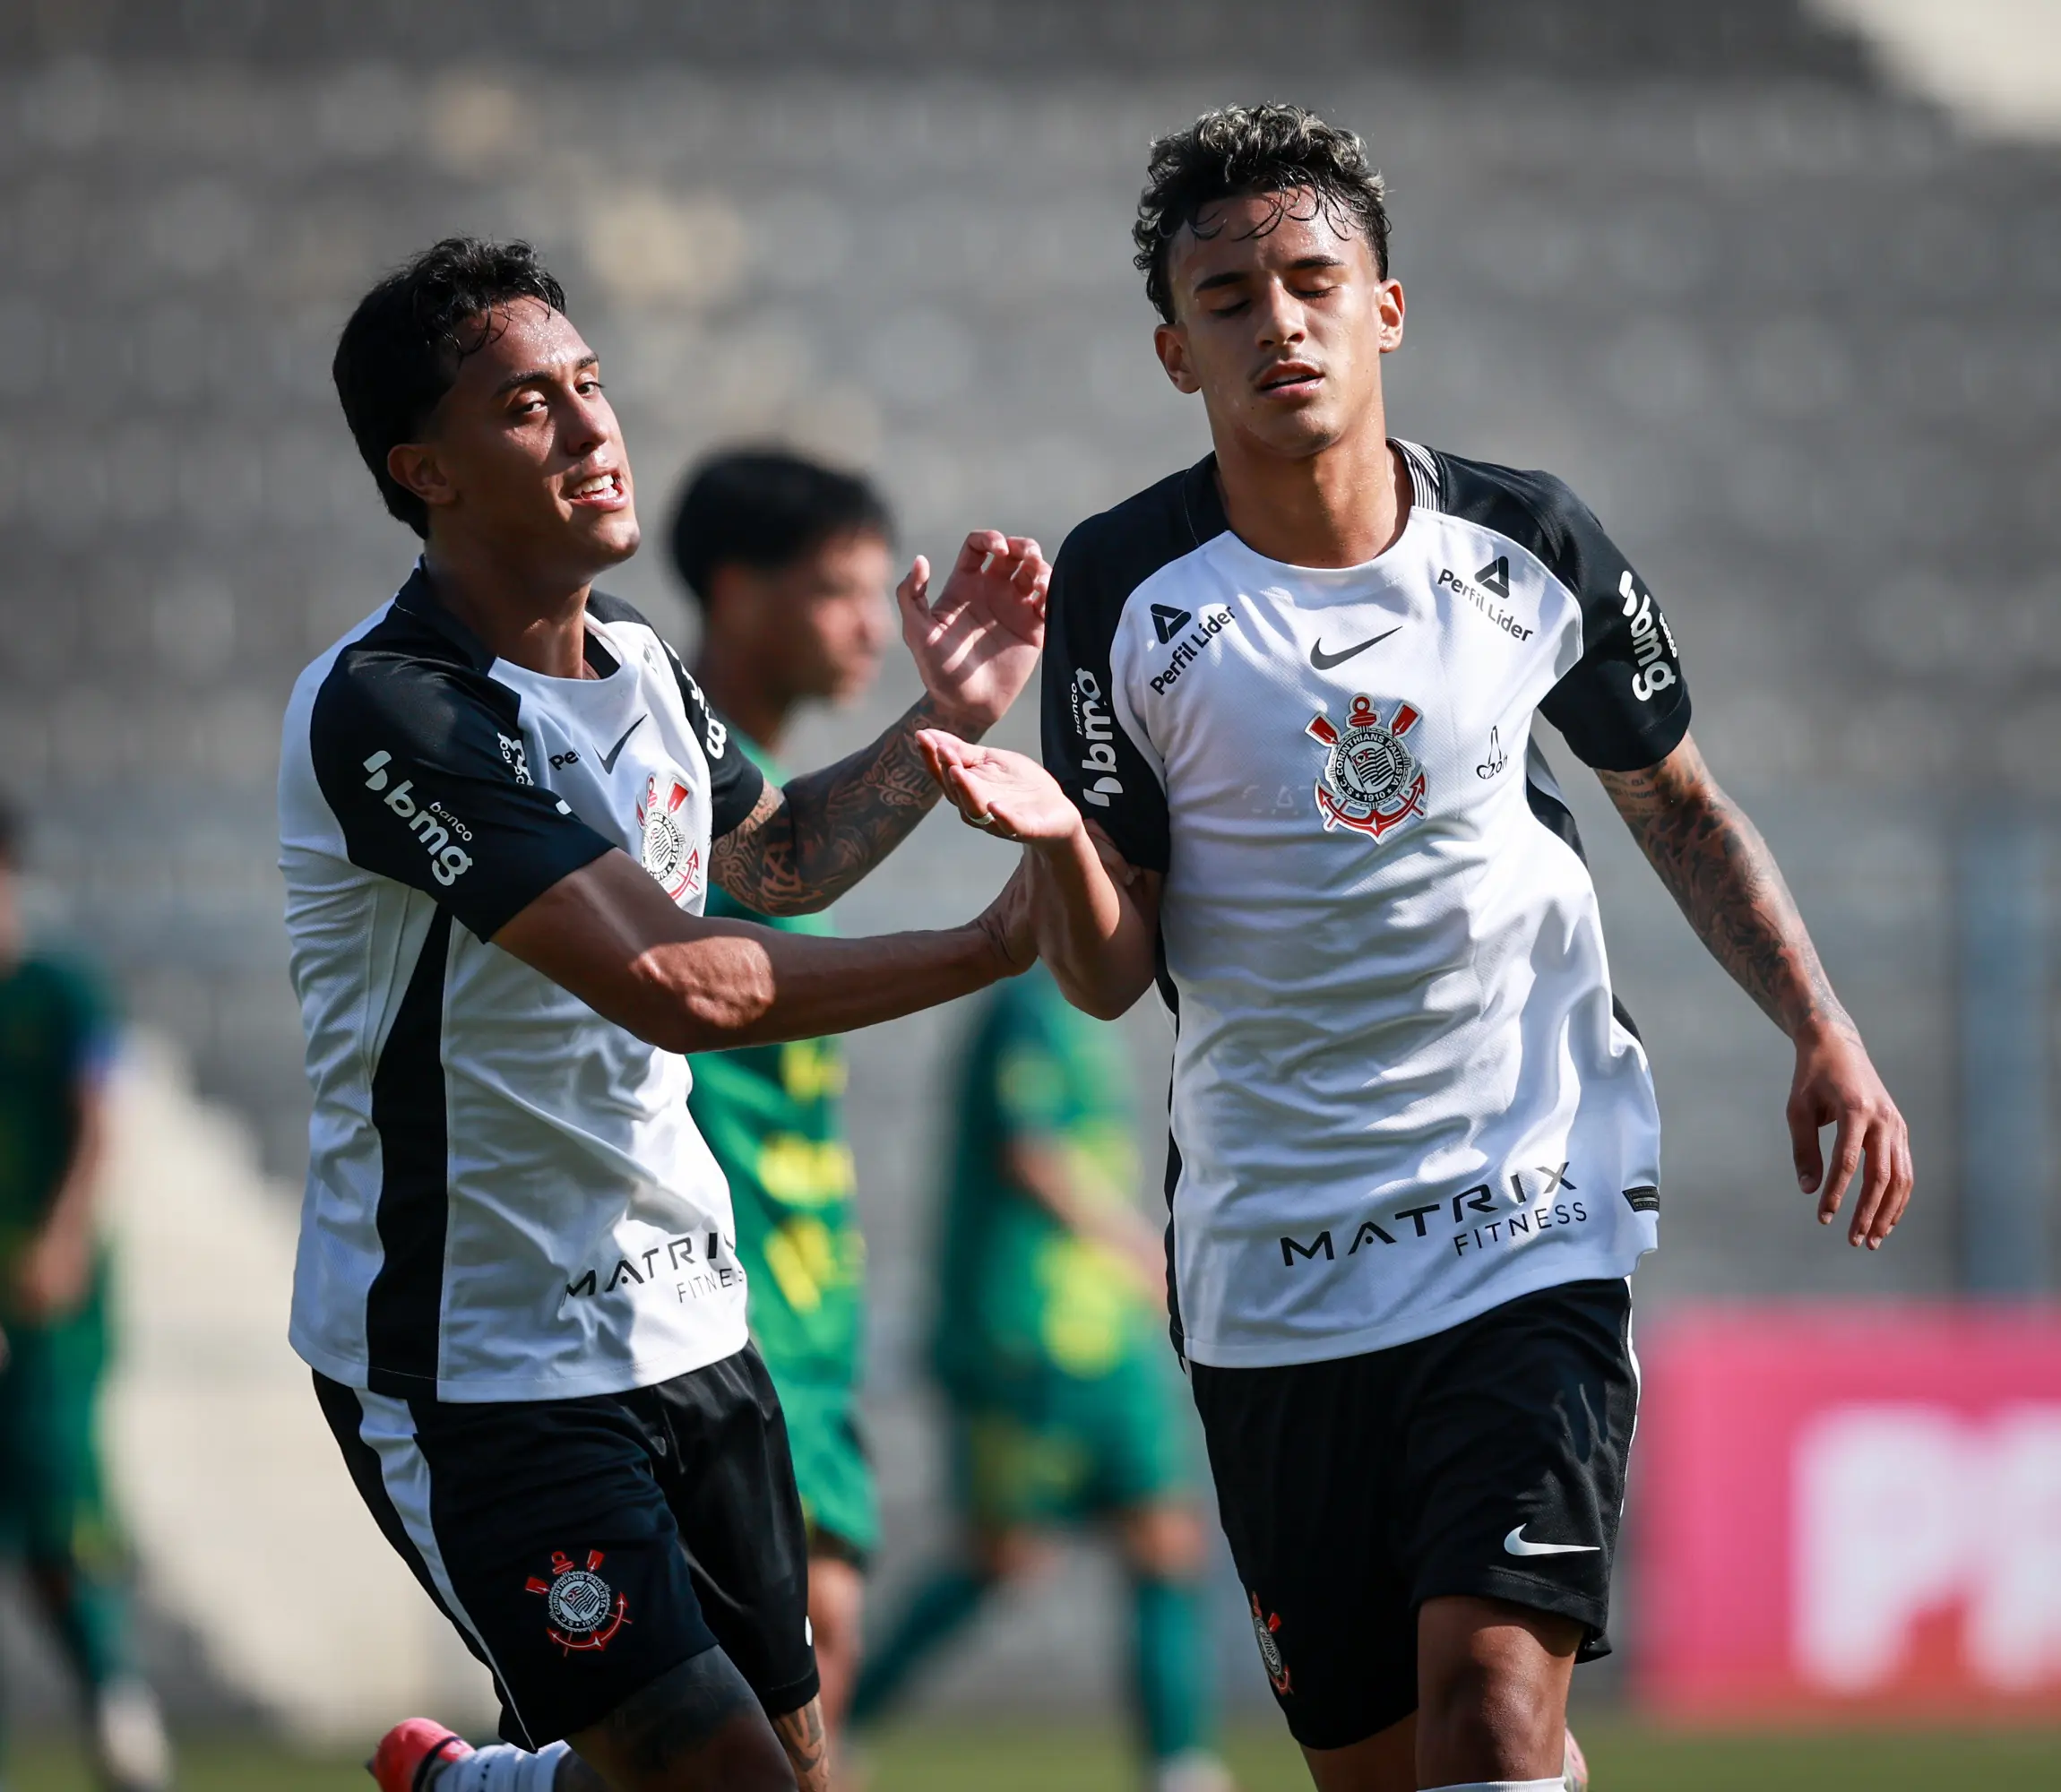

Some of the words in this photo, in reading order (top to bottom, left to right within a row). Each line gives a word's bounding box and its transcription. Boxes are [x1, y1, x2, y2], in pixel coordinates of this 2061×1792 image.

[1437, 569, 1484, 612] Perfil
[1488, 603, 1533, 642] Líder
[1150, 642, 1198, 695] Perfil
[1191, 606, 1236, 649] Líder
[1630, 594, 1677, 702] bmg
[1659, 612, 1677, 659] banco
[1071, 682, 1083, 736] banco
[1336, 733, 1385, 776] CORINTHIANS
[1384, 741, 1403, 786] PAULISTA
[429, 801, 473, 842] banco
[1363, 792, 1386, 802] 1910
[384, 780, 473, 887] bmg
[1280, 1161, 1577, 1267] MATRIX
[1453, 1202, 1588, 1256] FITNESS
[586, 1576, 607, 1608] PAULISTA
